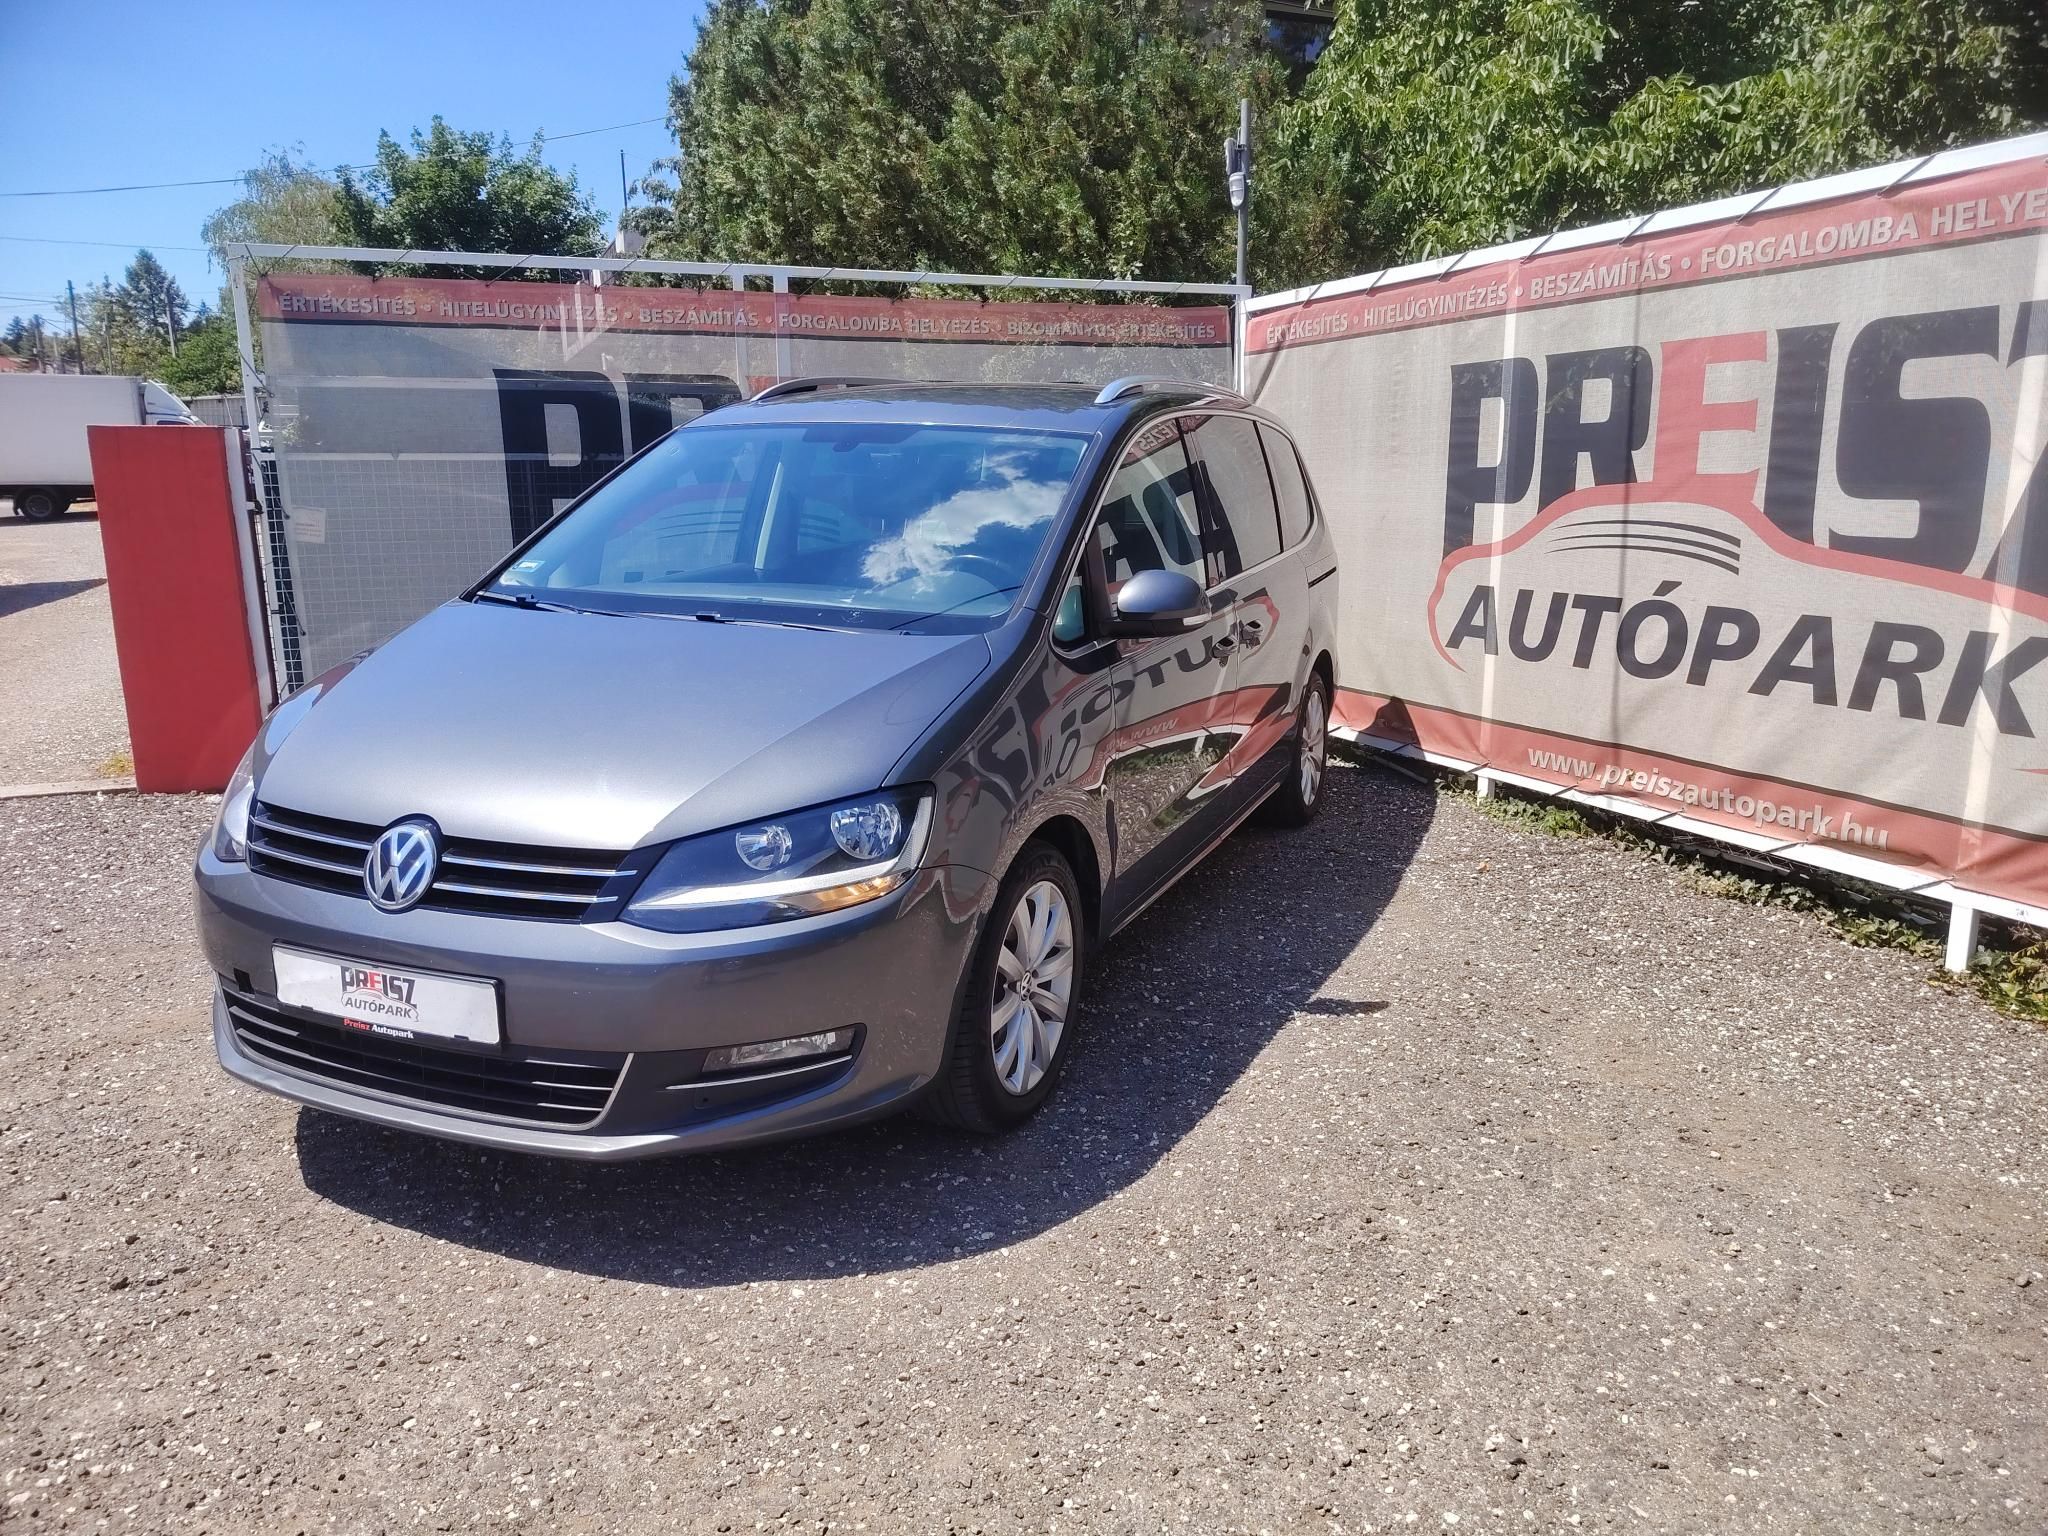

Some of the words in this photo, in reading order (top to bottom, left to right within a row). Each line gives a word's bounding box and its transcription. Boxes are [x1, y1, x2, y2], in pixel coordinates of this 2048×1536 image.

[1266, 310, 1348, 345] ÉRTÉKESÍTÉS
[1363, 282, 1508, 328] HITELÜGYINTÉZÉS
[1530, 253, 1672, 300] BESZÁMÍTÁS
[1701, 212, 1919, 273] FORGALOMBA
[279, 293, 416, 316] ÉRTÉKESÍTÉS
[440, 299, 618, 323] HITELÜGYINTÉZÉS
[639, 306, 760, 327] BESZÁMÍTÁS
[779, 312, 903, 333] FORGALOMBA
[908, 317, 991, 335] HELYEZÉS
[1445, 580, 2048, 739] AUTÓPARK
[1527, 747, 1890, 852] www.preiszautopark.hu
[340, 965, 417, 1008] PREISZ
[344, 996, 413, 1020] AUTÓPARK
[343, 1018, 371, 1032] Preisz
[371, 1024, 414, 1039] Autopark
